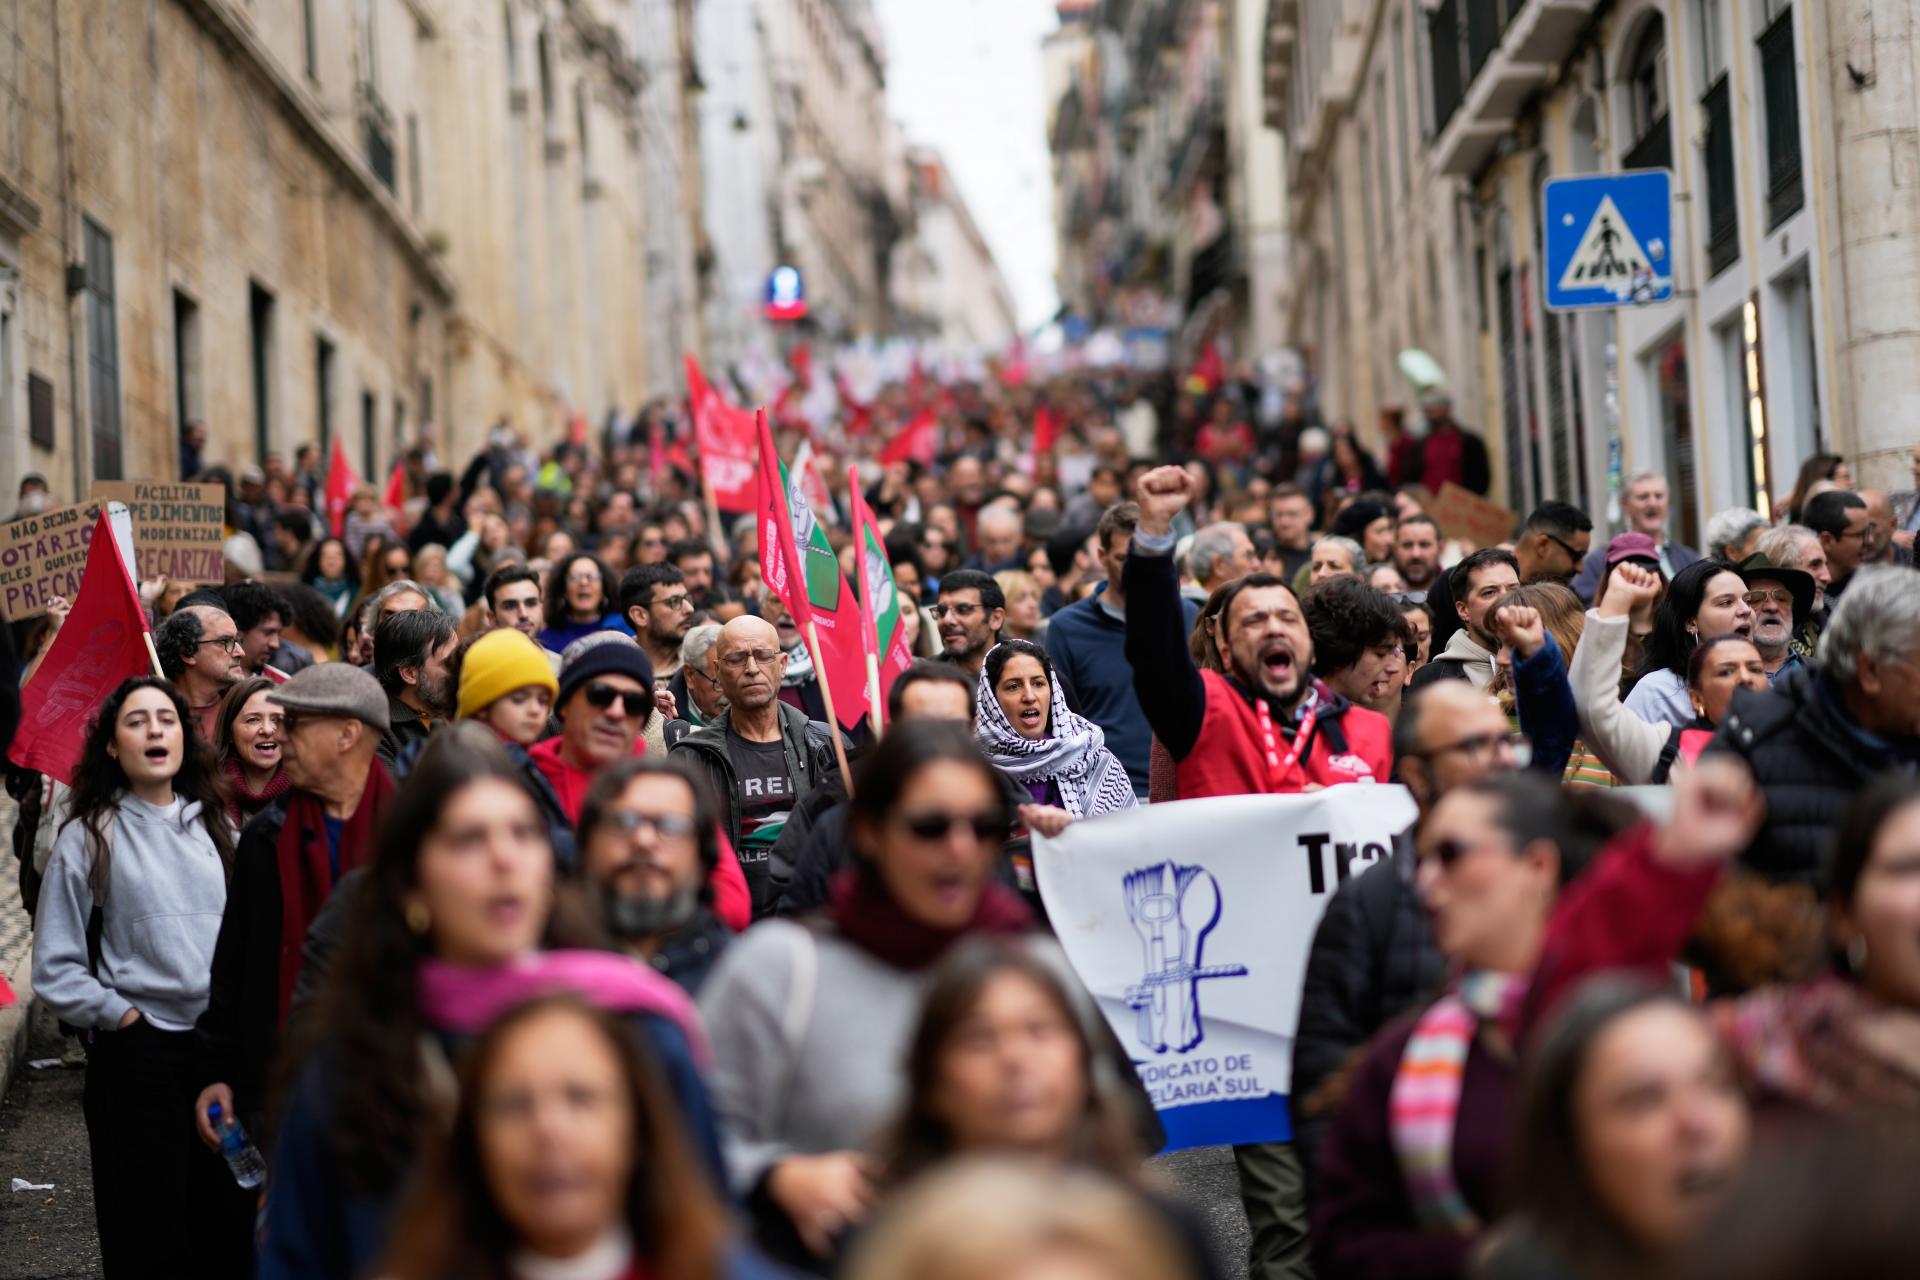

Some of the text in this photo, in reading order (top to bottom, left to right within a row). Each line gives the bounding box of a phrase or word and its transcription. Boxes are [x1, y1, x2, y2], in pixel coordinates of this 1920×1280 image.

[135, 485, 202, 500] FACILITAR
[129, 502, 223, 522] PEDIMENTOS
[11, 509, 78, 540] NÃO SEJAS
[140, 527, 222, 541] MODERNIZAR
[135, 545, 224, 580] RECARIZAR
[0, 566, 32, 585] ELES
[737, 777, 794, 796] RE
[738, 849, 769, 863] ALE
[1225, 1054, 1253, 1071] DE
